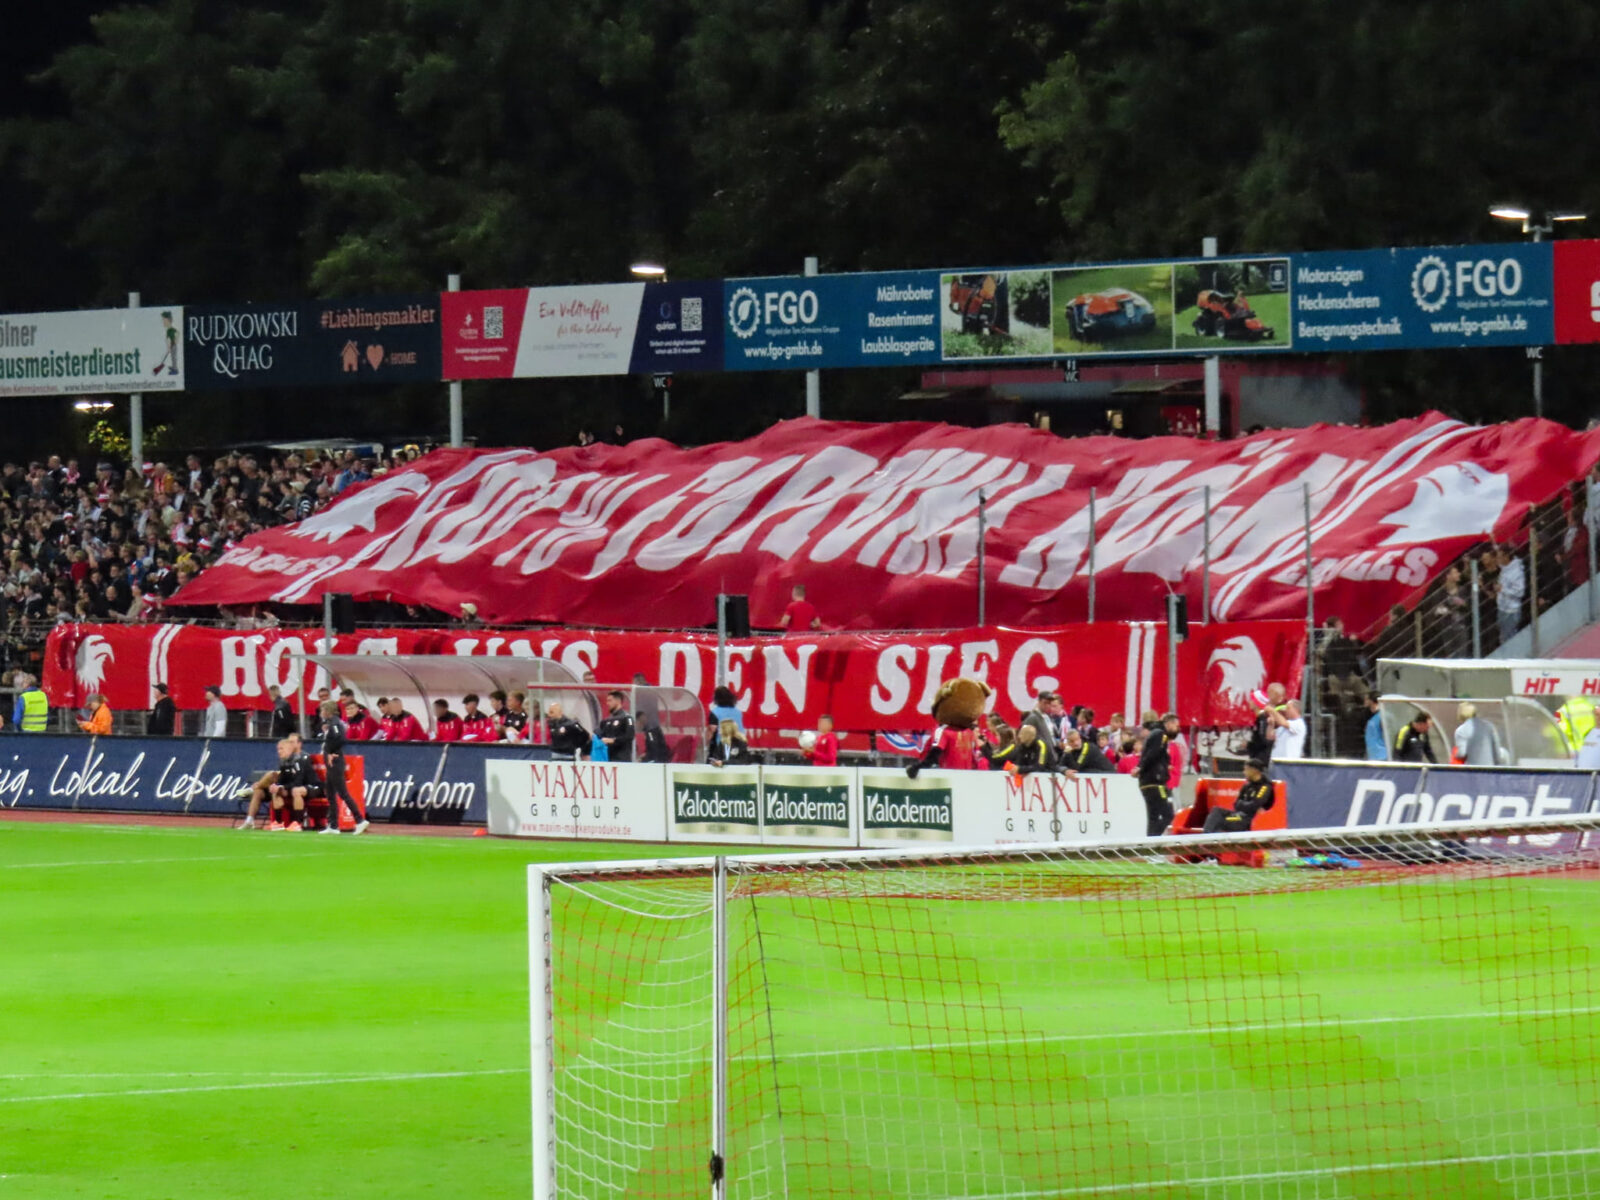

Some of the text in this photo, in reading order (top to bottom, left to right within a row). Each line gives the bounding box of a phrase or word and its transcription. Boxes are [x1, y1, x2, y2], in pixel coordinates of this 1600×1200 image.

[1298, 266, 1363, 286] Motorsägen
[1456, 258, 1522, 297] FGO
[877, 284, 934, 302] Mähroboter
[1298, 291, 1380, 310] Heckenscheren
[321, 304, 435, 331] #Lieblingsmakler
[765, 290, 819, 325] FGO
[868, 312, 934, 328] Rasentrimmer
[189, 311, 298, 346] RUDKOWSKI
[1298, 317, 1402, 341] Beregnungstechnik
[1430, 313, 1528, 336] www.fgo-gmbh.de
[744, 340, 823, 360] www.fgo-gmbh.de
[861, 337, 935, 356] Laubblasgeräte
[1526, 346, 1543, 358] WC
[653, 376, 666, 388] WC
[220, 634, 398, 700] HOL
[658, 641, 818, 715] DEN
[869, 638, 1061, 715] SIEG
[1524, 677, 1560, 694] HIT
[50, 751, 146, 798] Lokal.
[530, 764, 619, 800] MAXIM
[677, 788, 756, 819] Kaloderma
[766, 789, 847, 821] Kaloderma
[1005, 775, 1109, 813] MAXIM
[866, 792, 950, 824] Kaloderma
